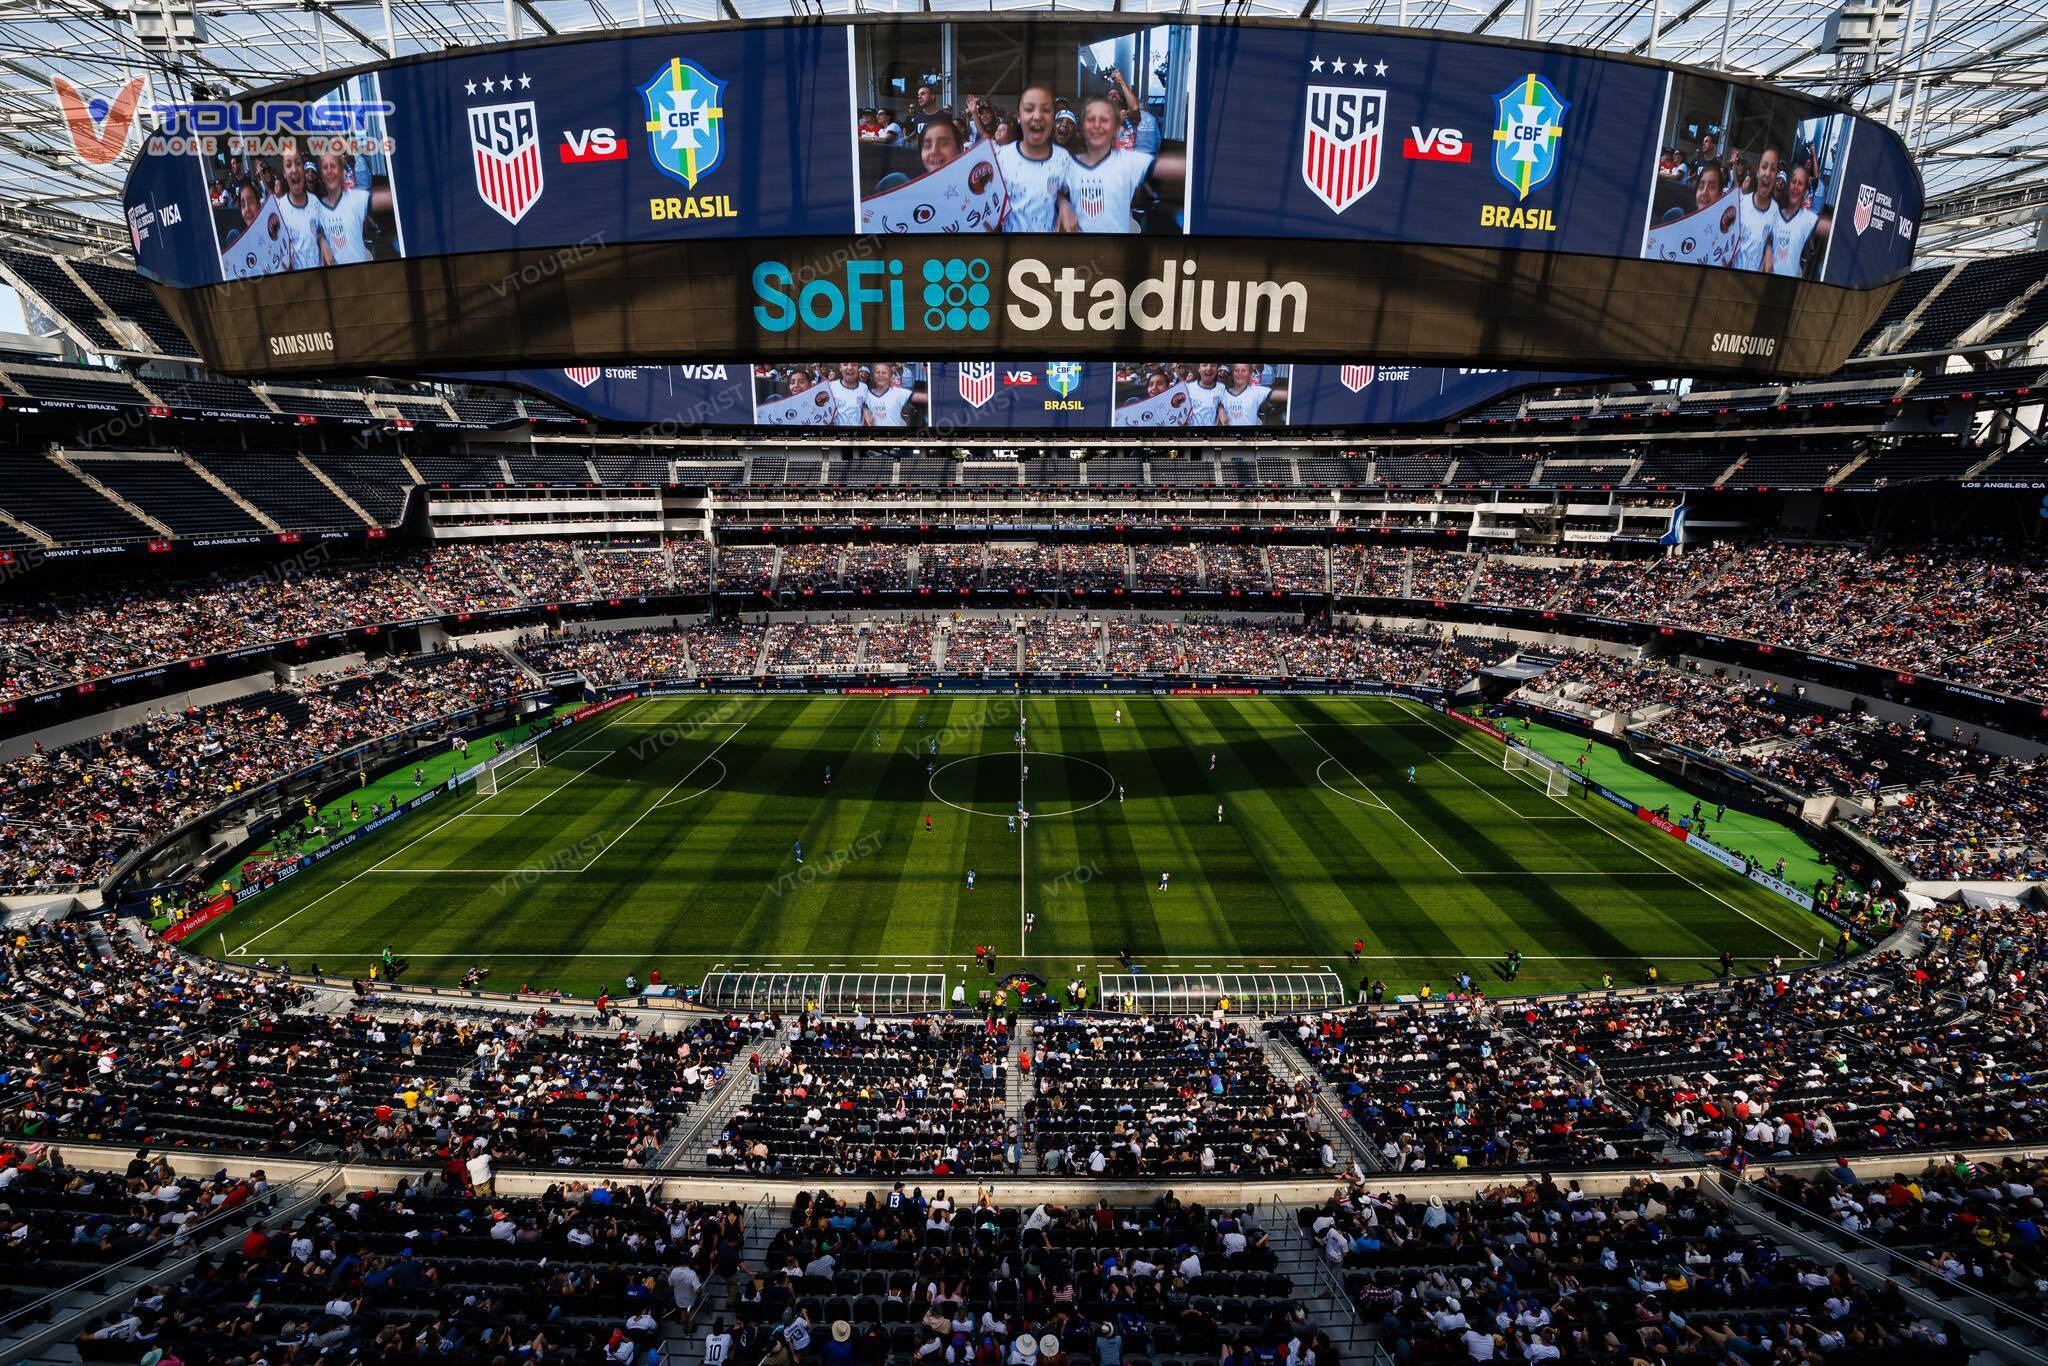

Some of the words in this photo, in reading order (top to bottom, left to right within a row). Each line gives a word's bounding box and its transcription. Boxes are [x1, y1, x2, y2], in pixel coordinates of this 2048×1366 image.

[668, 111, 700, 128] CBF
[1311, 92, 1381, 142] USA
[473, 108, 533, 157] USA
[563, 127, 617, 156] VS
[1411, 126, 1463, 155] VS
[1514, 125, 1543, 142] CBF
[158, 203, 182, 227] VISA
[650, 195, 738, 220] BRASIL
[1480, 205, 1557, 231] BRASIL
[1899, 216, 1913, 240] VISA
[752, 258, 906, 332] SoFi
[1006, 258, 1308, 333] Stadium
[270, 331, 334, 356] SAMSUNG
[1711, 332, 1775, 357] SAMSUNG
[605, 369, 637, 380] STORE
[1007, 371, 1032, 382] VS
[1056, 366, 1071, 375] CBF
[1378, 371, 1410, 382] STORE
[1044, 401, 1085, 410] BRASIL
[1983, 481, 2030, 490] ANGELES,
[43, 549, 80, 559] USWNT
[92, 545, 126, 555] BRAZIL
[1807, 654, 1829, 664] USWNT
[1836, 660, 1857, 670] BRAZIL
[144, 668, 167, 678] BRAZIL
[34, 694, 56, 703] APRIL
[1945, 685, 1960, 694] LOS
[1994, 696, 2006, 706] CA
[1601, 788, 1633, 810] Volkswagen
[364, 808, 402, 832] Volkswagen
[316, 847, 331, 860] New
[331, 839, 345, 852] York
[345, 833, 357, 846] Life
[1689, 838, 1702, 848] BANK
[1709, 849, 1730, 863] AMERICA
[277, 862, 298, 879] TRULY
[235, 883, 260, 900] TRULY
[183, 913, 208, 932] Henkel
[1818, 907, 1851, 929] MARRIOTT
[889, 1195, 900, 1209] 13
[709, 1344, 722, 1362] 10
